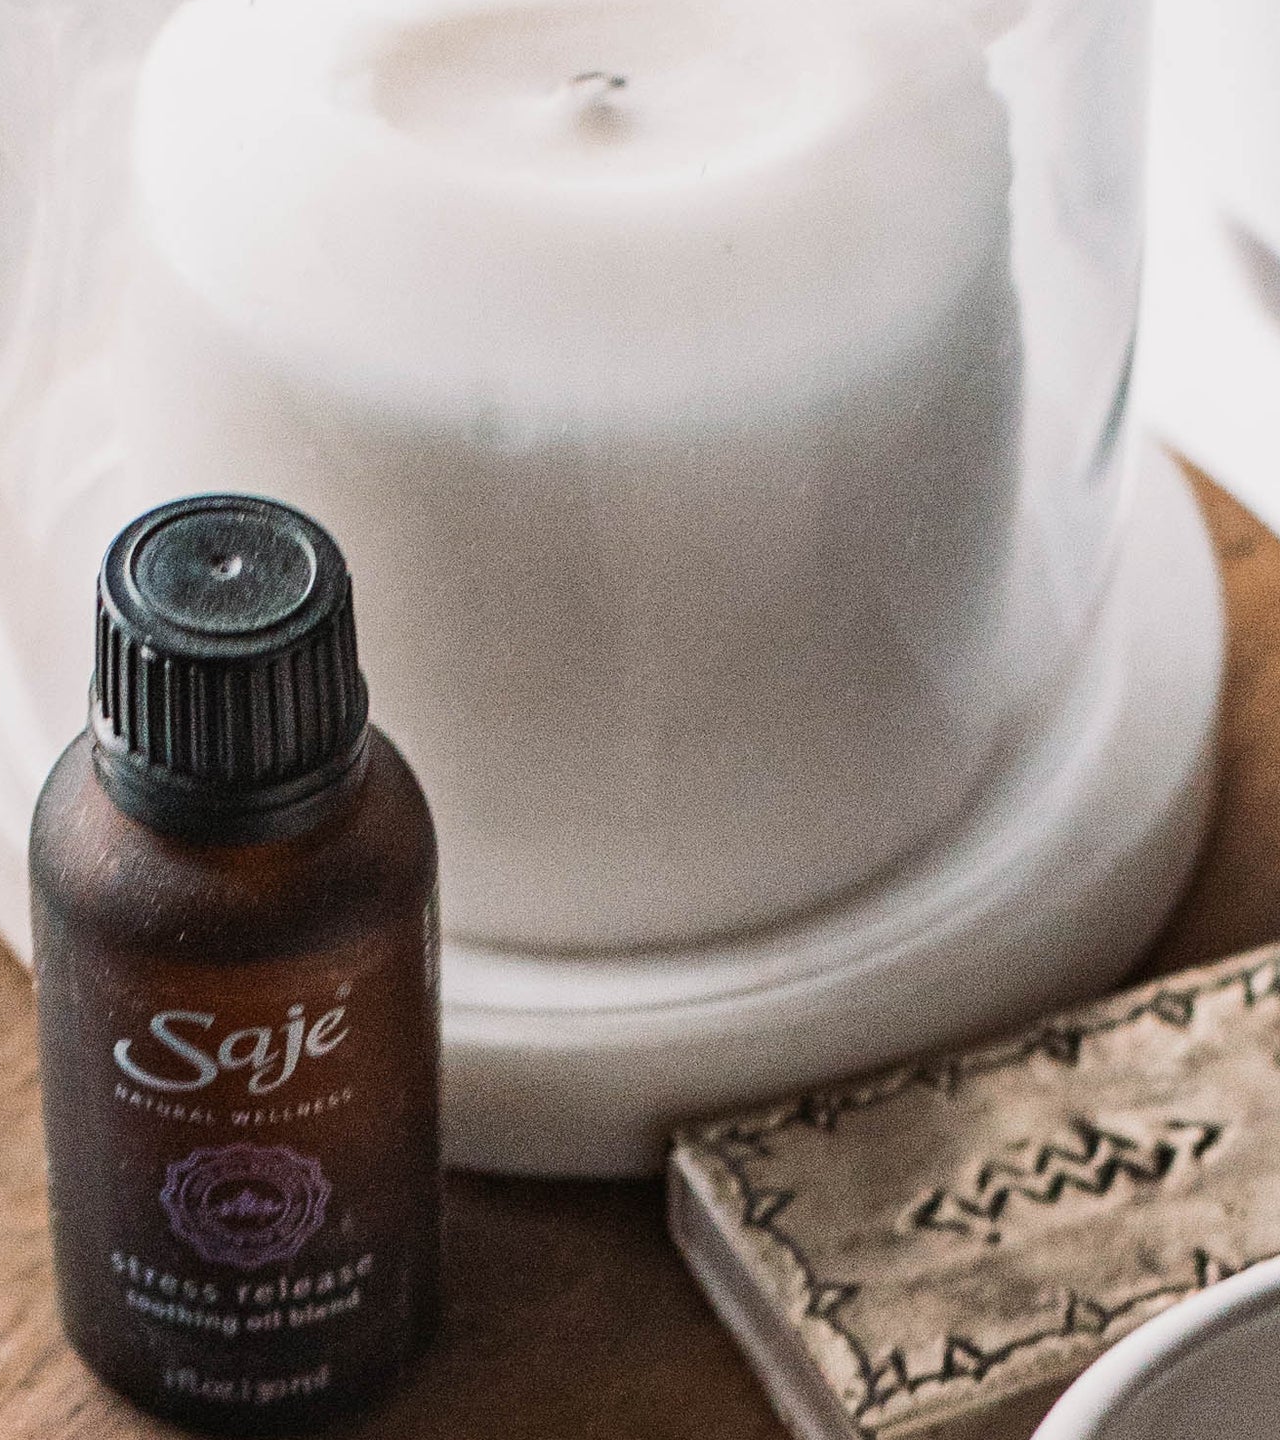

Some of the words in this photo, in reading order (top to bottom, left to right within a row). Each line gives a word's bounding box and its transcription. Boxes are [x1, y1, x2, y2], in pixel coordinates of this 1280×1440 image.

[114, 1082, 216, 1127] NATURAL
[231, 1086, 352, 1126] WELLNESS
[111, 1251, 219, 1304] stress
[236, 1253, 374, 1305] release
[126, 1289, 239, 1336] soothing
[288, 1286, 360, 1328] blend
